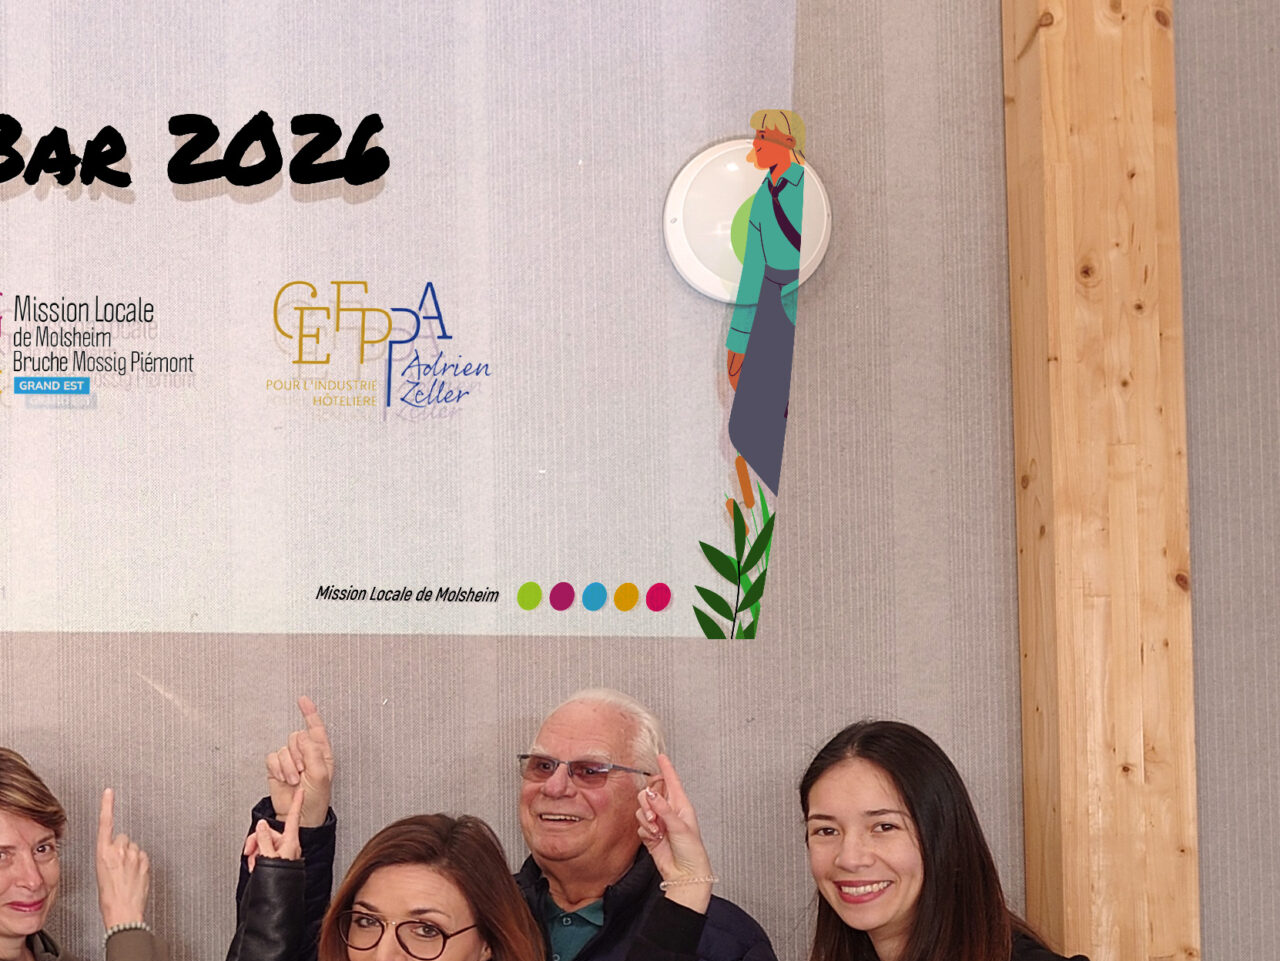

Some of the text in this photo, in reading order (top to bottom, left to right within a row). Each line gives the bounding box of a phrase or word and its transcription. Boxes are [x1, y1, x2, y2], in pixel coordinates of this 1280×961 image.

[167, 109, 391, 187] 2026
[14, 295, 154, 322] Mission Locale
[13, 326, 111, 347] de Molsheim
[13, 350, 194, 375] Bruche Mossig Piémont
[401, 349, 491, 380] Adrien
[19, 381, 85, 391] GRAND EST
[266, 379, 377, 391] POUR L'INDUSTRIE
[400, 379, 470, 407] Zeller
[316, 585, 500, 603] Mission Locale de Molsheim
